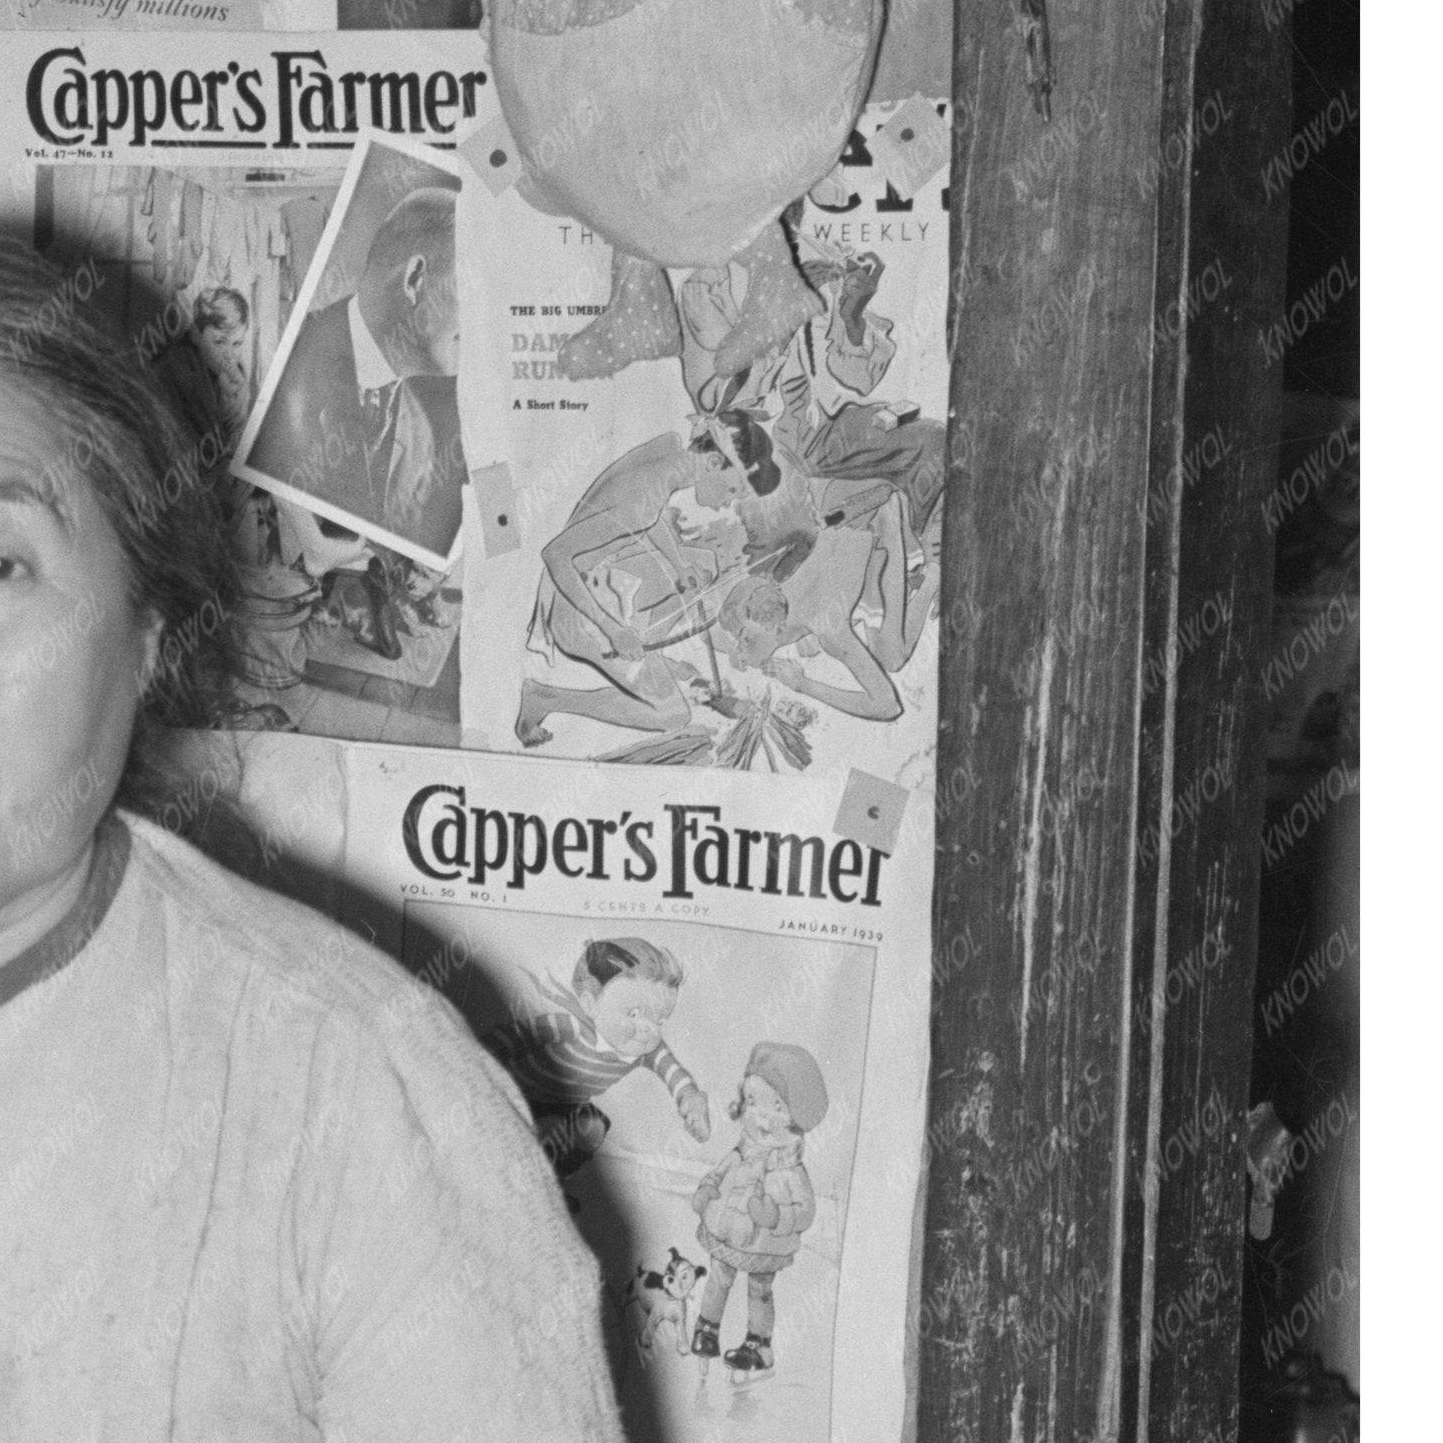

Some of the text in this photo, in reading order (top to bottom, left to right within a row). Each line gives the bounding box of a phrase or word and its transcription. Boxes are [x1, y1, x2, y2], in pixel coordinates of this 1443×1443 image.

[25, 45, 488, 150] Capper's Farmer
[25, 148, 114, 159] Vol. 12
[814, 222, 931, 242] WEEKLY
[510, 306, 562, 317] THE BIG
[513, 399, 589, 413] A Short Story
[402, 783, 892, 908] Capper's Farmer
[400, 884, 496, 904] VOL. 50 NO.
[597, 902, 711, 918] CENTS COPY
[779, 918, 884, 943] JANUARY 1939
